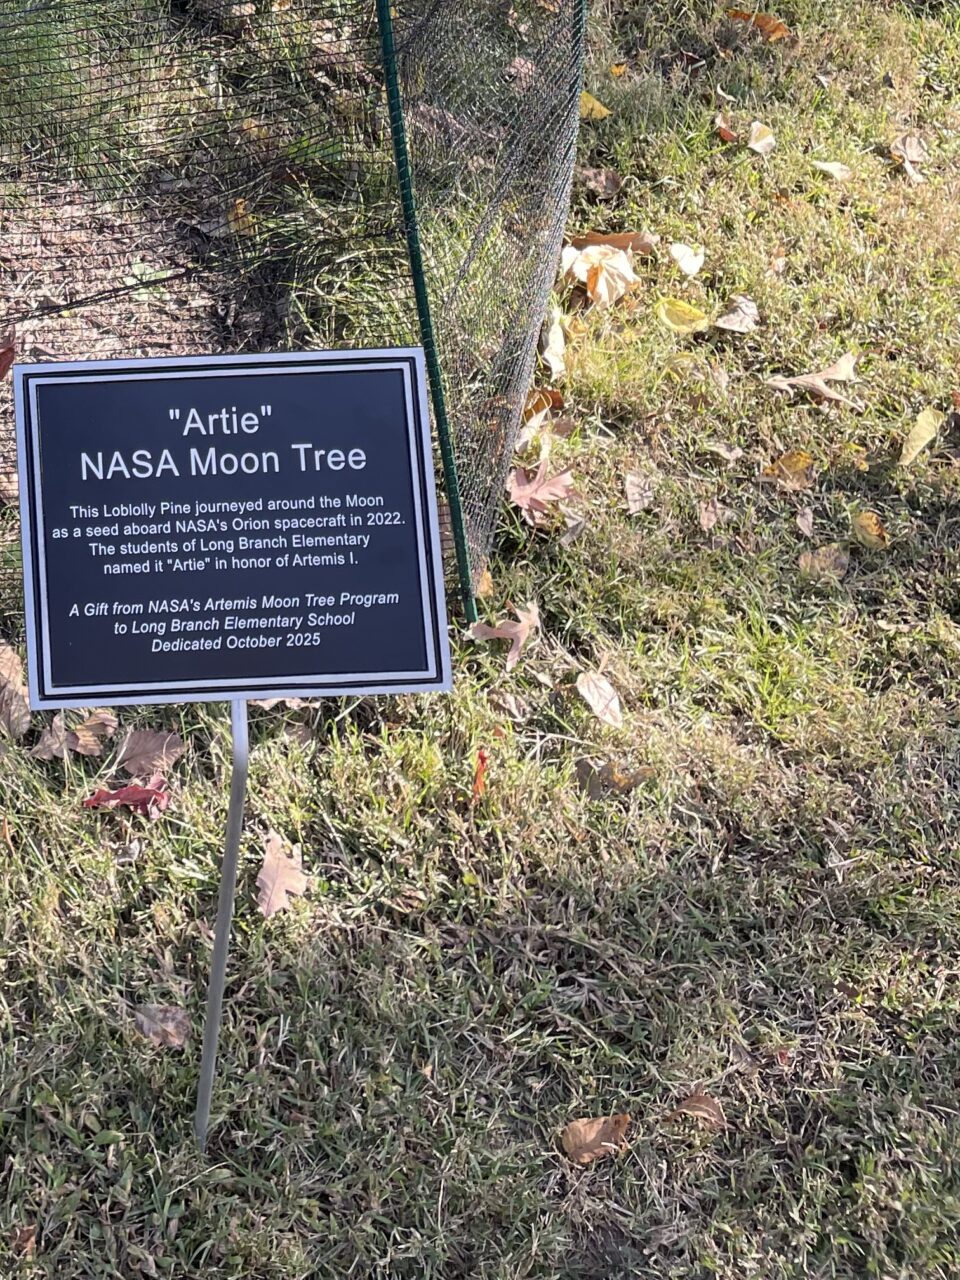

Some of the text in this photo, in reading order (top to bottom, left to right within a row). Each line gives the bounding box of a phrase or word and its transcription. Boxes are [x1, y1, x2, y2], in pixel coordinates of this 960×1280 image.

[168, 404, 272, 436] "Artie"
[80, 443, 367, 481] NASA Moon Tree
[69, 494, 384, 519] This Loblolly Pine journeyed around the Moon
[52, 511, 406, 539] as a seed aboard NASA's Orion spacecraft in 2022.
[88, 533, 370, 556] The students of Long Branch Elementary
[103, 551, 358, 575] named it "Artie" in honor of Artemis I.
[68, 592, 400, 617] A Gift from NASA's Artemis Moon Tree Program
[114, 611, 356, 636] to Long Branch Elementary School
[151, 632, 321, 653] Dedicated October 2025
